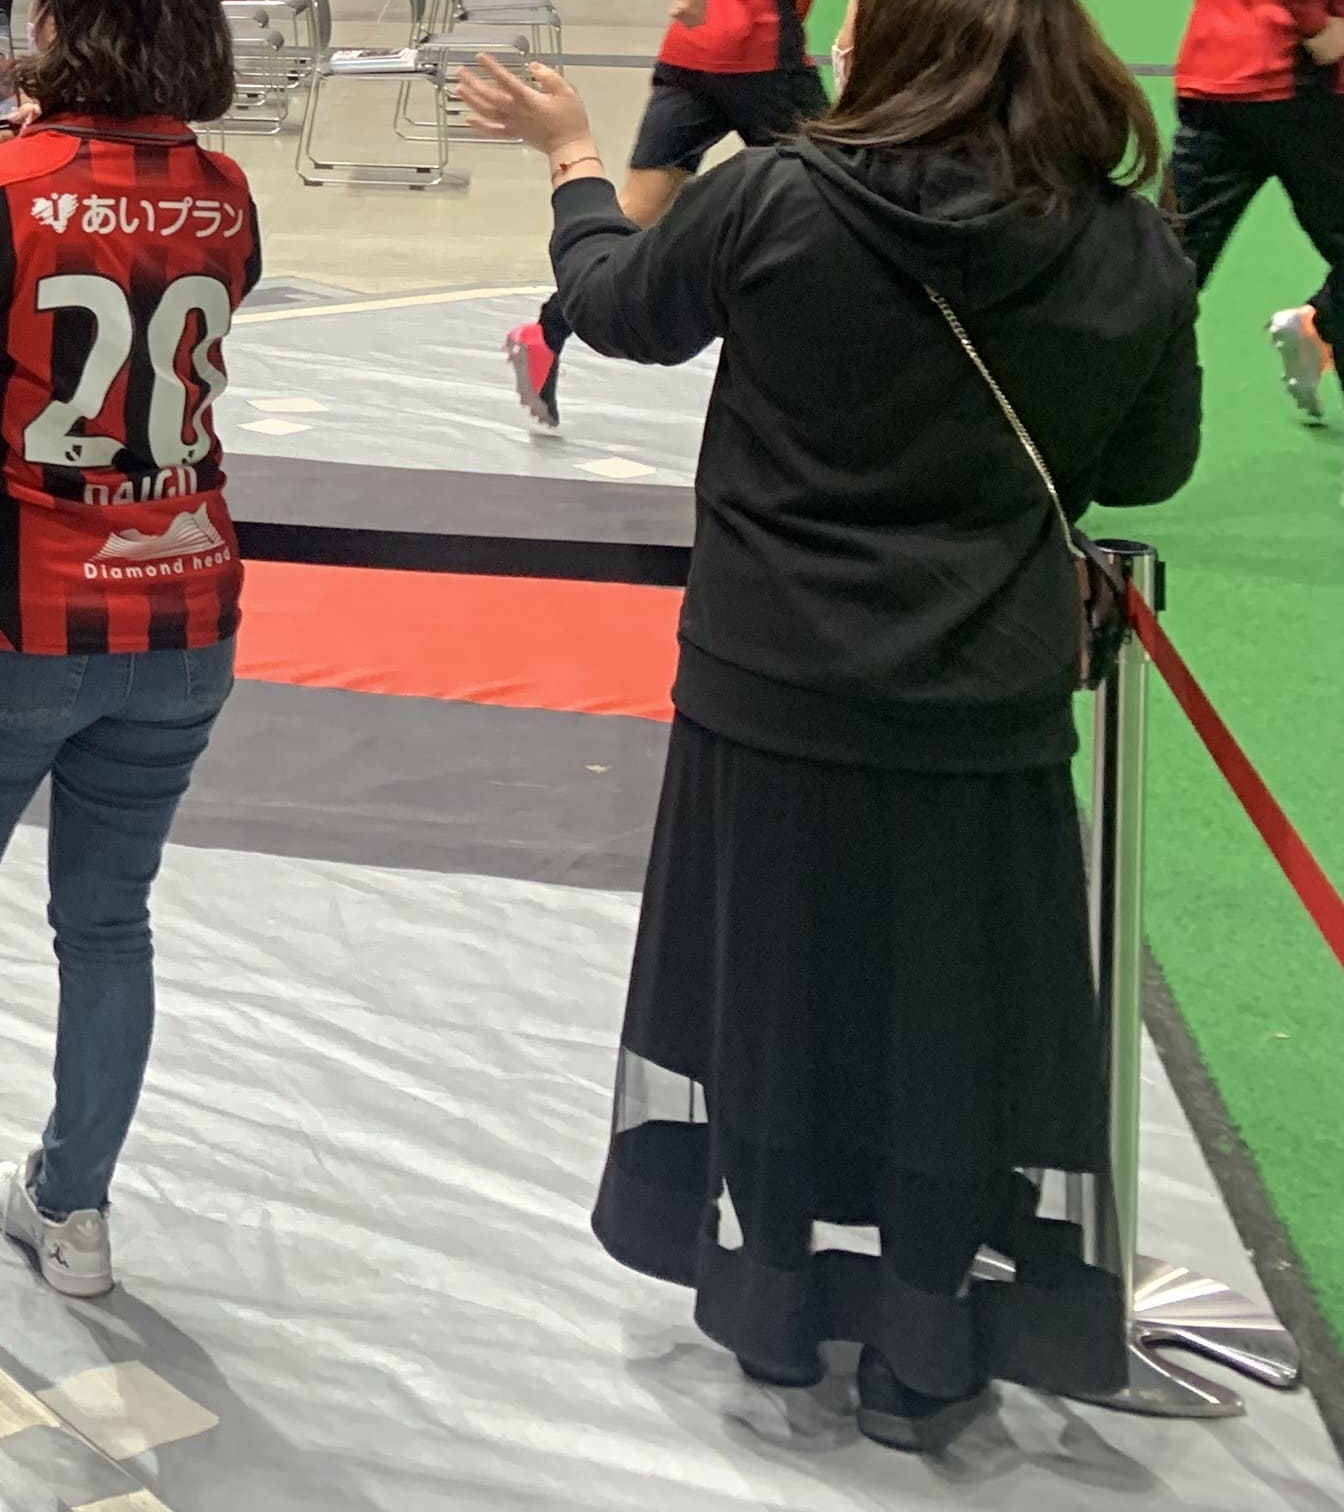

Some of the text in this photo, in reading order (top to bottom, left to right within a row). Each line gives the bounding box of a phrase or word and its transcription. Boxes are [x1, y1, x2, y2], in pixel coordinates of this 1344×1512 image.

[81, 194, 244, 238] あいプラン
[24, 273, 232, 469] 20
[83, 546, 232, 580] Diamond head
